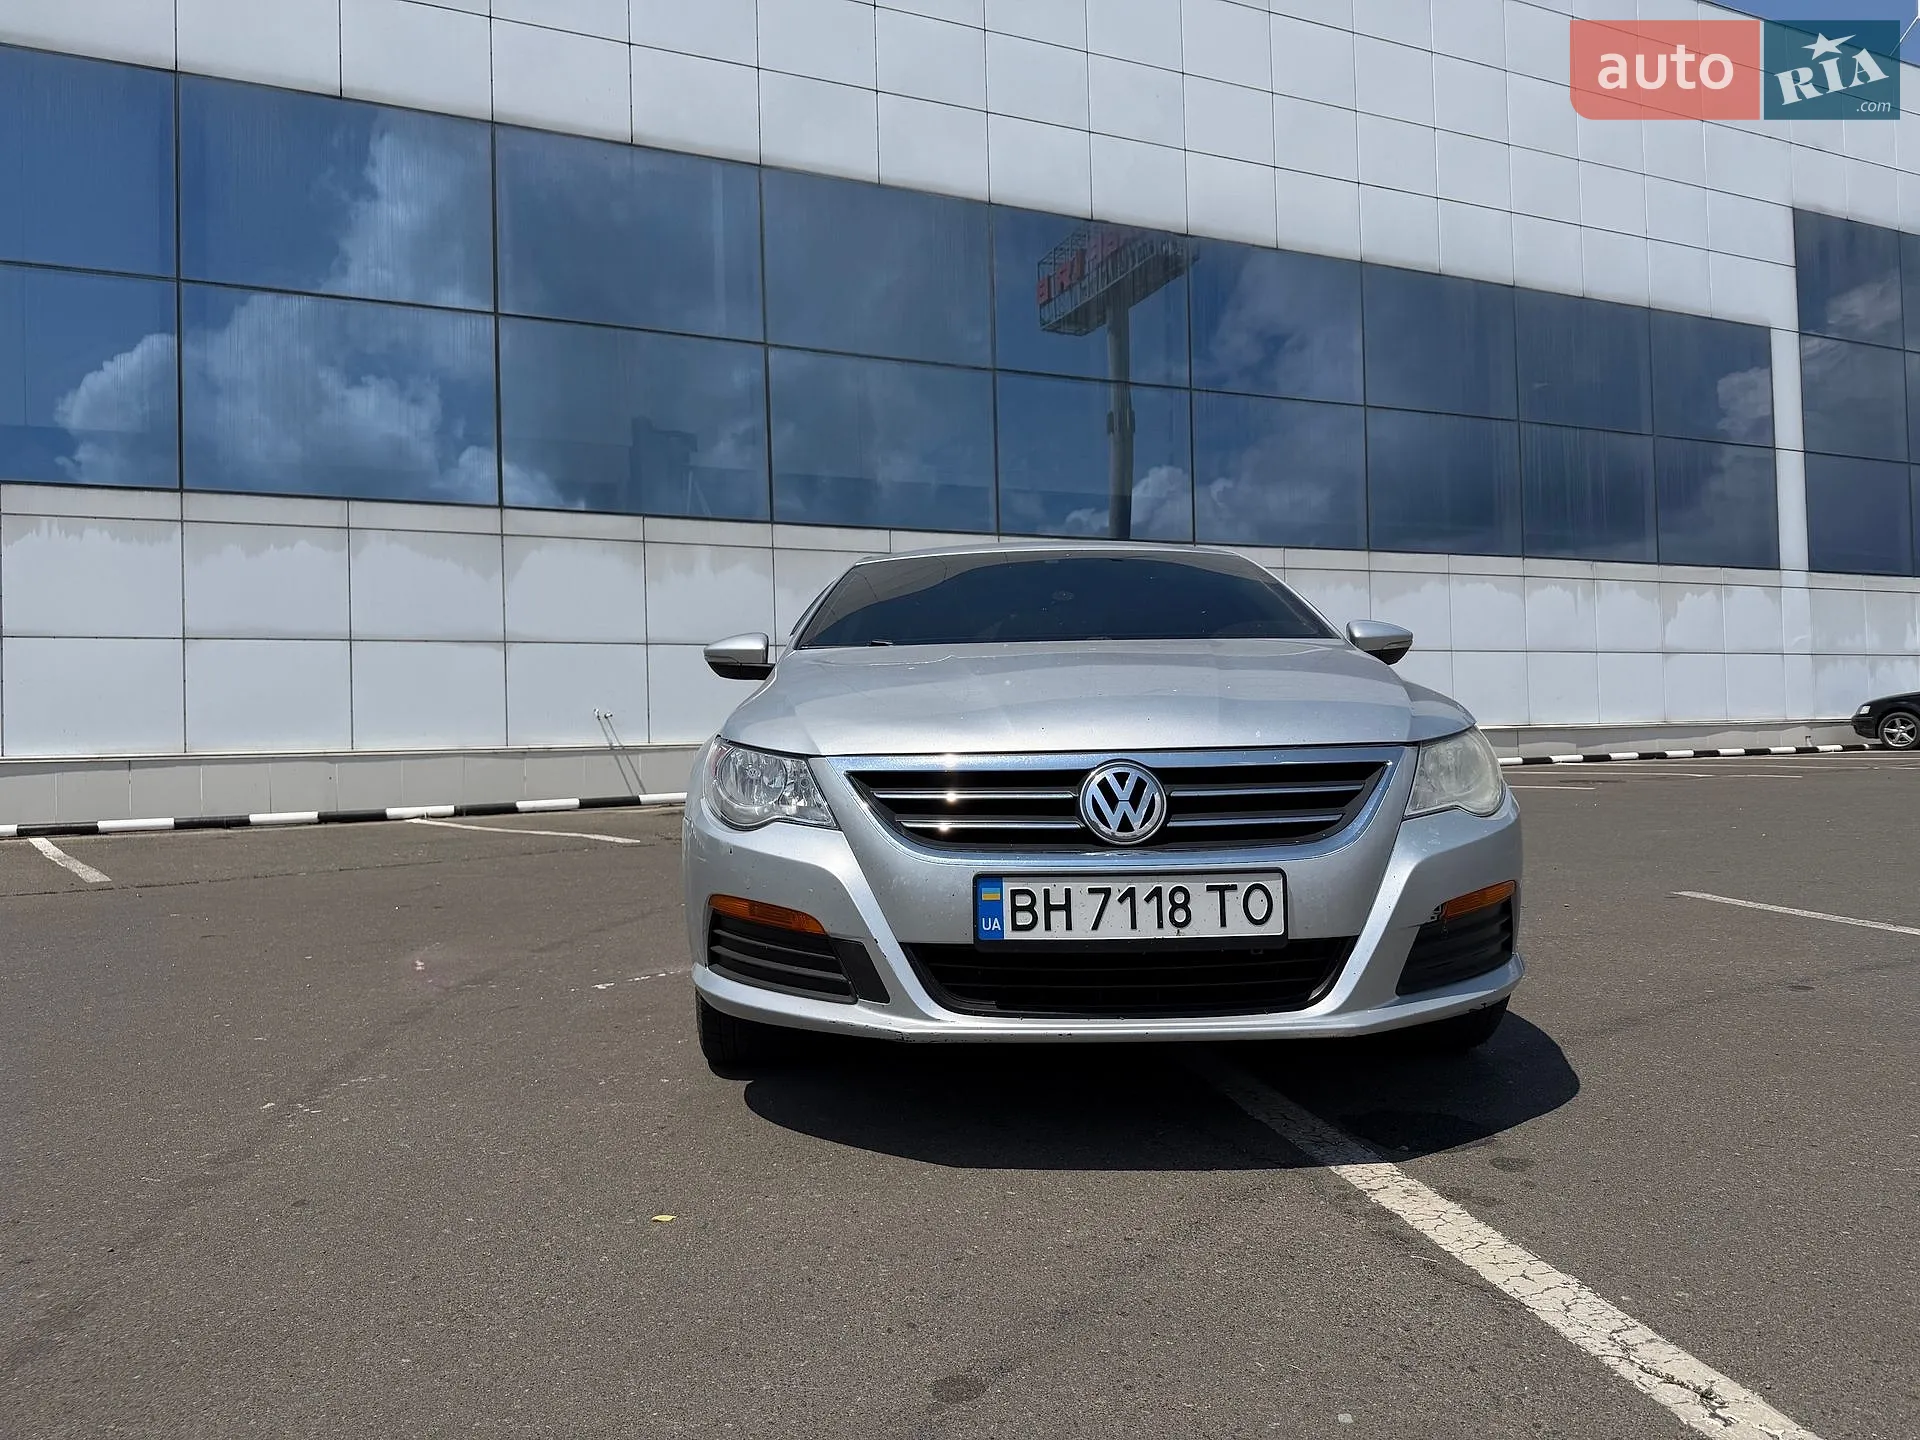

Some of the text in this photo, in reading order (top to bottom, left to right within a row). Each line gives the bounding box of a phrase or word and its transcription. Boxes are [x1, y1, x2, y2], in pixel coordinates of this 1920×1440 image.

[1084, 765, 1161, 838] VW
[982, 919, 1001, 931] UA
[1009, 882, 1274, 932] BH 7118 TO
